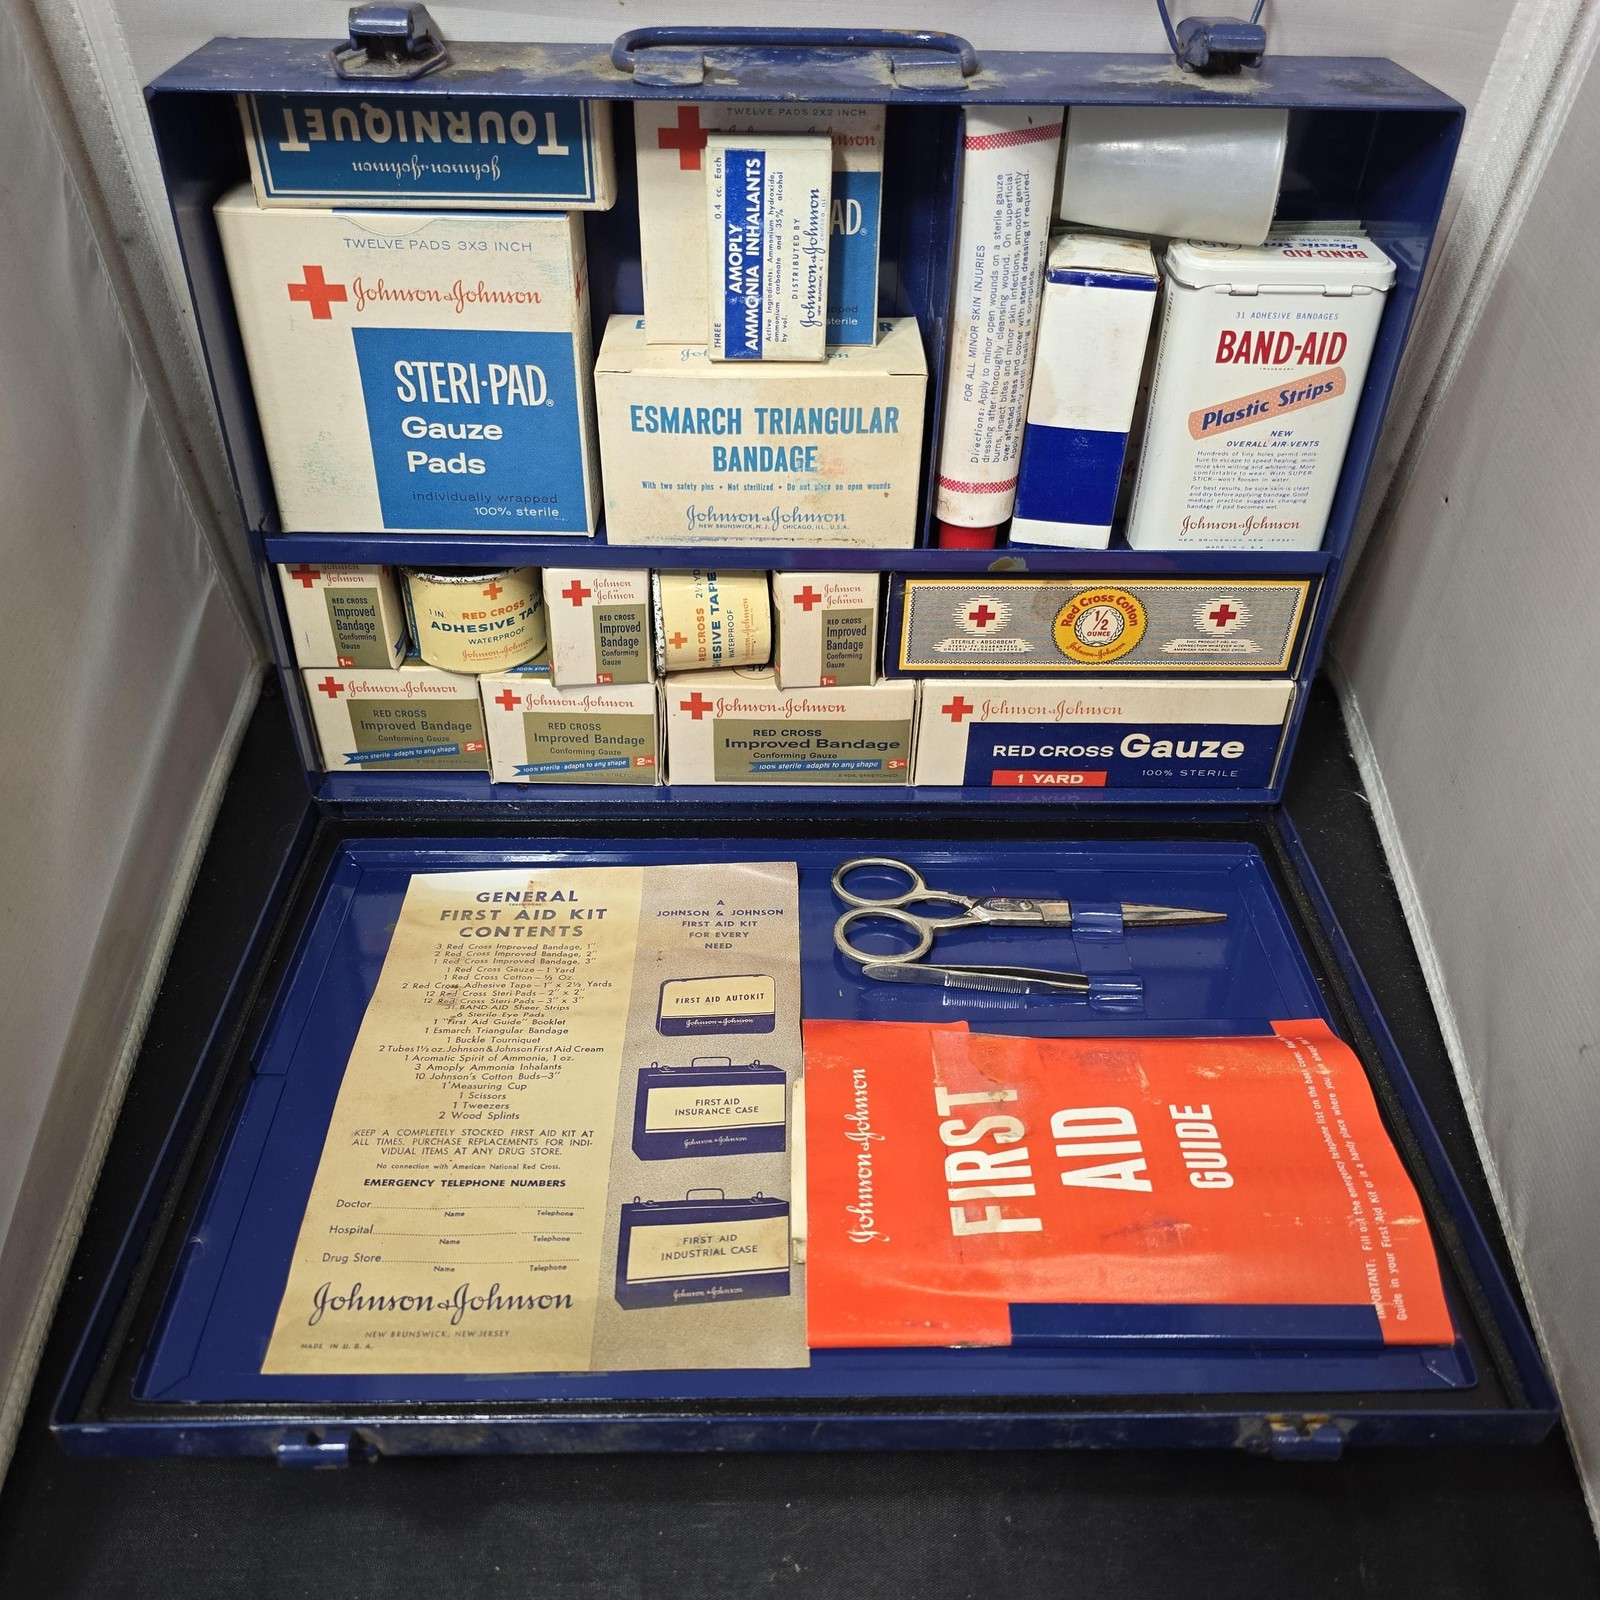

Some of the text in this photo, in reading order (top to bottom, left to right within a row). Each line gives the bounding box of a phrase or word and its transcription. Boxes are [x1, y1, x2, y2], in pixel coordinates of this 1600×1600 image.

[727, 108, 773, 116] TWELVE
[279, 103, 569, 156] TOURNIQUET
[714, 157, 722, 179] Each
[996, 174, 1004, 206] gauze
[714, 204, 722, 220] 0.4
[793, 218, 800, 231] BY
[993, 209, 1003, 242] sterile
[344, 238, 532, 253] TWELVE PADS 3X3 INCH
[729, 224, 743, 294] AMOPLY
[745, 159, 761, 351] AMMONIA INHALANTS
[992, 254, 1000, 267] on
[989, 270, 999, 307] wounds
[963, 245, 985, 402] FOR ALL MINOR SKIN INJURIES
[987, 309, 996, 333] open
[1235, 312, 1339, 321] 31 ADHESIVE BANDAGES
[983, 336, 993, 364] minor
[1216, 330, 1348, 365] BAND-AID
[981, 367, 989, 377] to
[979, 381, 989, 405] Apply
[1202, 380, 1334, 431] Plastic Strips
[631, 404, 899, 435] ESMARCH TRIANGULAR
[401, 416, 503, 440] Gauze
[971, 408, 985, 463] Directions:
[407, 451, 486, 474] Pads
[713, 446, 818, 473] BANDAGE
[642, 481, 714, 492] With two safety pins
[413, 491, 558, 504] individually wrapped
[474, 507, 559, 517] 100% sterile
[333, 606, 376, 618] Improved
[462, 600, 525, 620] RED CROSS
[1060, 594, 1138, 628] Red Cross Cotton
[336, 620, 376, 633] Bandage
[431, 618, 515, 633] ADHESIVE
[599, 621, 642, 636] Improved
[827, 627, 867, 638] Improved
[468, 626, 525, 645] WATERPROOF
[697, 608, 707, 662] RED CROSS
[727, 610, 735, 658] WATERPROOF
[1086, 630, 1111, 638] OUNCE
[600, 635, 639, 650] Bandage
[826, 640, 864, 652] Bandage
[601, 649, 639, 658] Conforming
[373, 710, 427, 718] RED CROSS
[361, 720, 472, 732] Improved Bandage
[776, 729, 822, 737] CROSS
[725, 738, 900, 751] Improved Bandage
[993, 733, 1245, 759] RED CROSS Gauze
[753, 751, 807, 760] Conforming
[1017, 774, 1084, 784] 1 YARD
[1142, 769, 1239, 778] 100% STERILE
[476, 891, 579, 903] GENERAL
[440, 909, 608, 921] FIRST AID KIT
[459, 926, 584, 937] CONTENTS
[543, 944, 583, 952] Bandage,
[726, 993, 765, 1002] AUTOKIT
[476, 1027, 524, 1036] Triangular
[529, 1027, 569, 1035] Bandage
[675, 1106, 759, 1116] INSURANCE CASE
[1050, 1106, 1153, 1194] AID
[1170, 1104, 1235, 1189] GUIDE
[935, 1086, 1044, 1238] FIRST
[364, 1179, 566, 1188] EMERGENCY TELEPHONE NUMBERS
[683, 1236, 712, 1245] FIRST
[322, 1253, 348, 1264] Drug
[661, 1245, 758, 1261] INDUSTRIAL CASE
